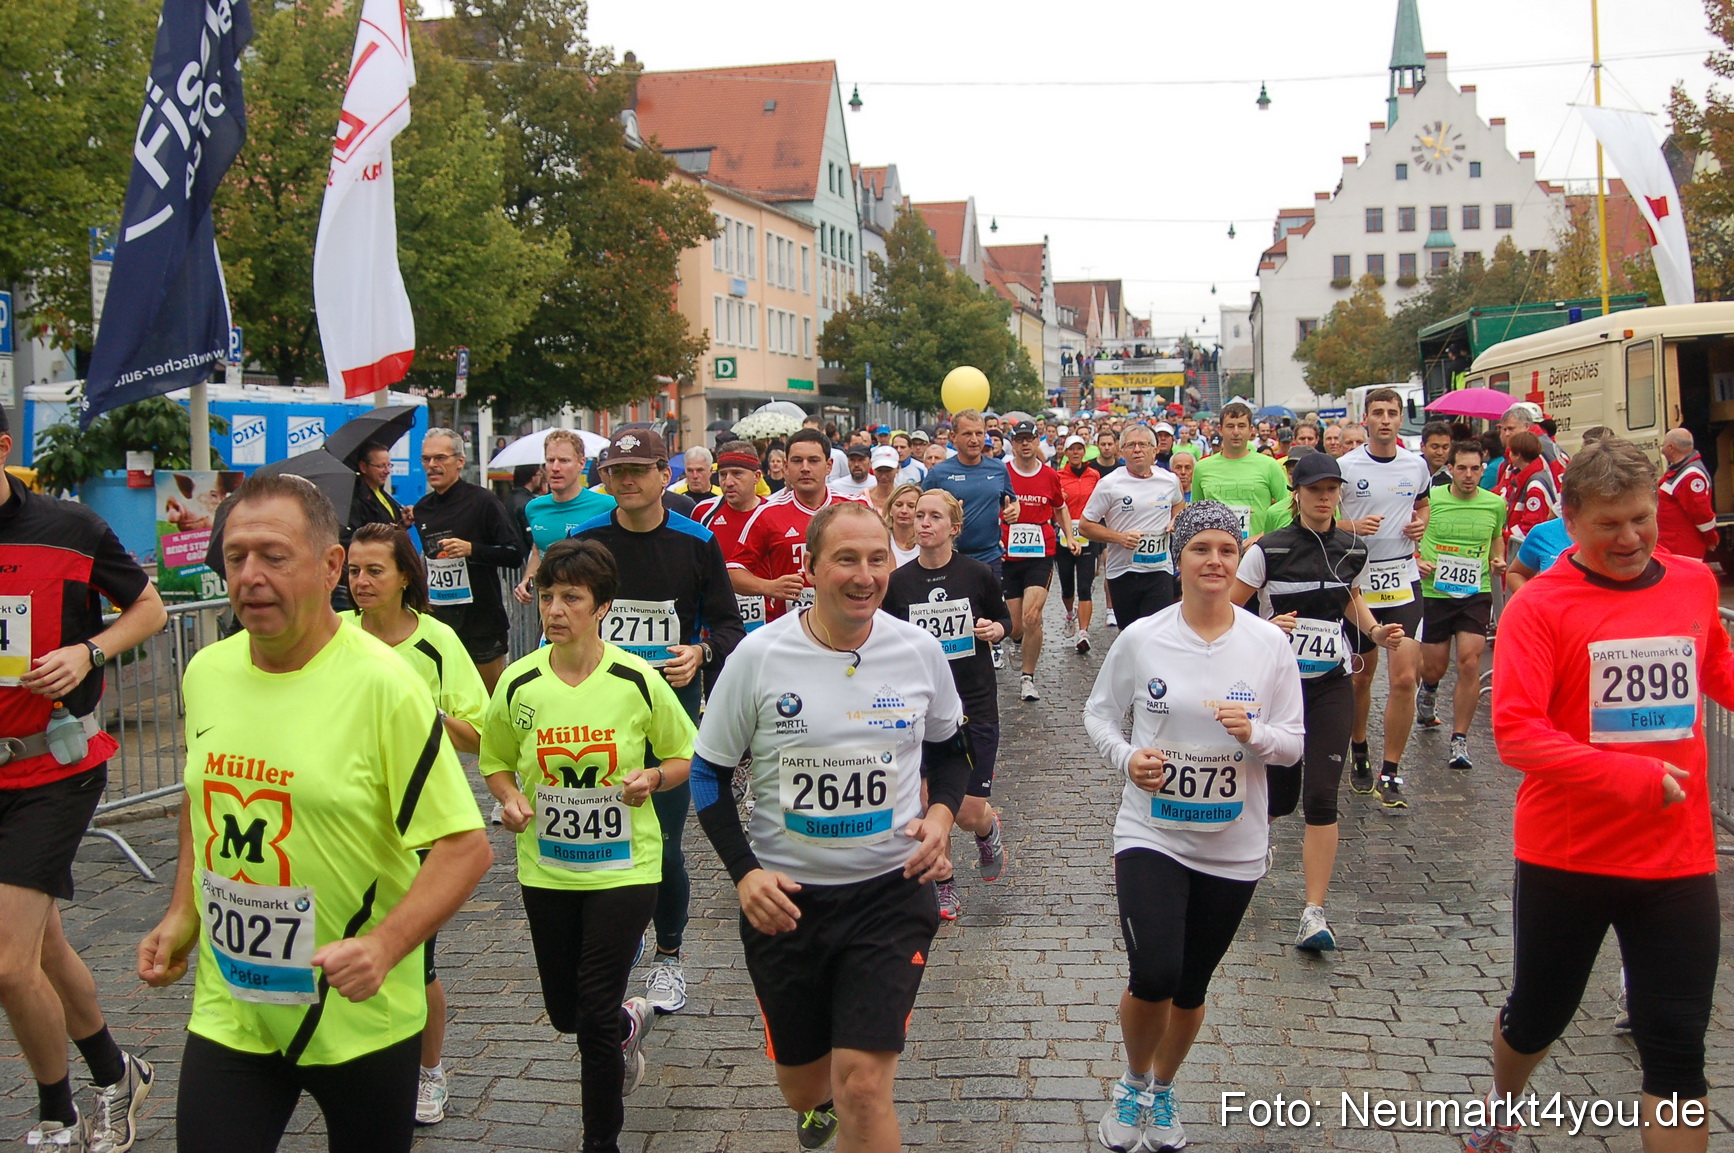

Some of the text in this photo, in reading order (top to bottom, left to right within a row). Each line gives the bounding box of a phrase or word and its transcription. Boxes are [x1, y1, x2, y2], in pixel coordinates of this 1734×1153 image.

[717, 359, 734, 377] D
[1549, 361, 1599, 388] Bayerisches
[1123, 376, 1154, 385] START
[1549, 390, 1572, 409] Rotes
[1013, 532, 1041, 544] 2374
[1138, 537, 1166, 554] 2611
[1436, 544, 1460, 553] MERZ
[430, 569, 463, 588] 2497
[1370, 572, 1401, 591] 525
[1440, 565, 1477, 585] 2485
[1381, 593, 1395, 601] Alex
[630, 606, 666, 614] Neumarkt
[740, 602, 761, 620] 55
[931, 606, 961, 614] Neumarkt
[610, 616, 670, 642] 2711
[1301, 624, 1331, 634] Neumarkt
[942, 642, 957, 652] cole
[1593, 648, 1679, 661] PARTL Neumarkt
[1602, 661, 1689, 703] 2898
[1147, 700, 1170, 710] PARTL
[776, 720, 808, 729] PARTL
[1631, 711, 1666, 728] Felix
[536, 725, 616, 746] Müller
[782, 755, 877, 768] PARTL Neumarkt
[1161, 749, 1230, 763] ARTL Neumarkt
[204, 752, 295, 787] Müller
[1159, 762, 1237, 799] 2673
[537, 791, 613, 806] PARTL Neumarkt
[792, 769, 888, 811] 2646
[1161, 803, 1232, 822] Margaretha
[545, 806, 622, 840] 2349
[806, 817, 873, 837] Siegfried
[219, 813, 268, 864] M
[554, 844, 613, 860] Rosmarie
[202, 878, 289, 911] PARTL Neumarkt
[208, 901, 301, 960] 2027
[230, 963, 270, 986] Peter
